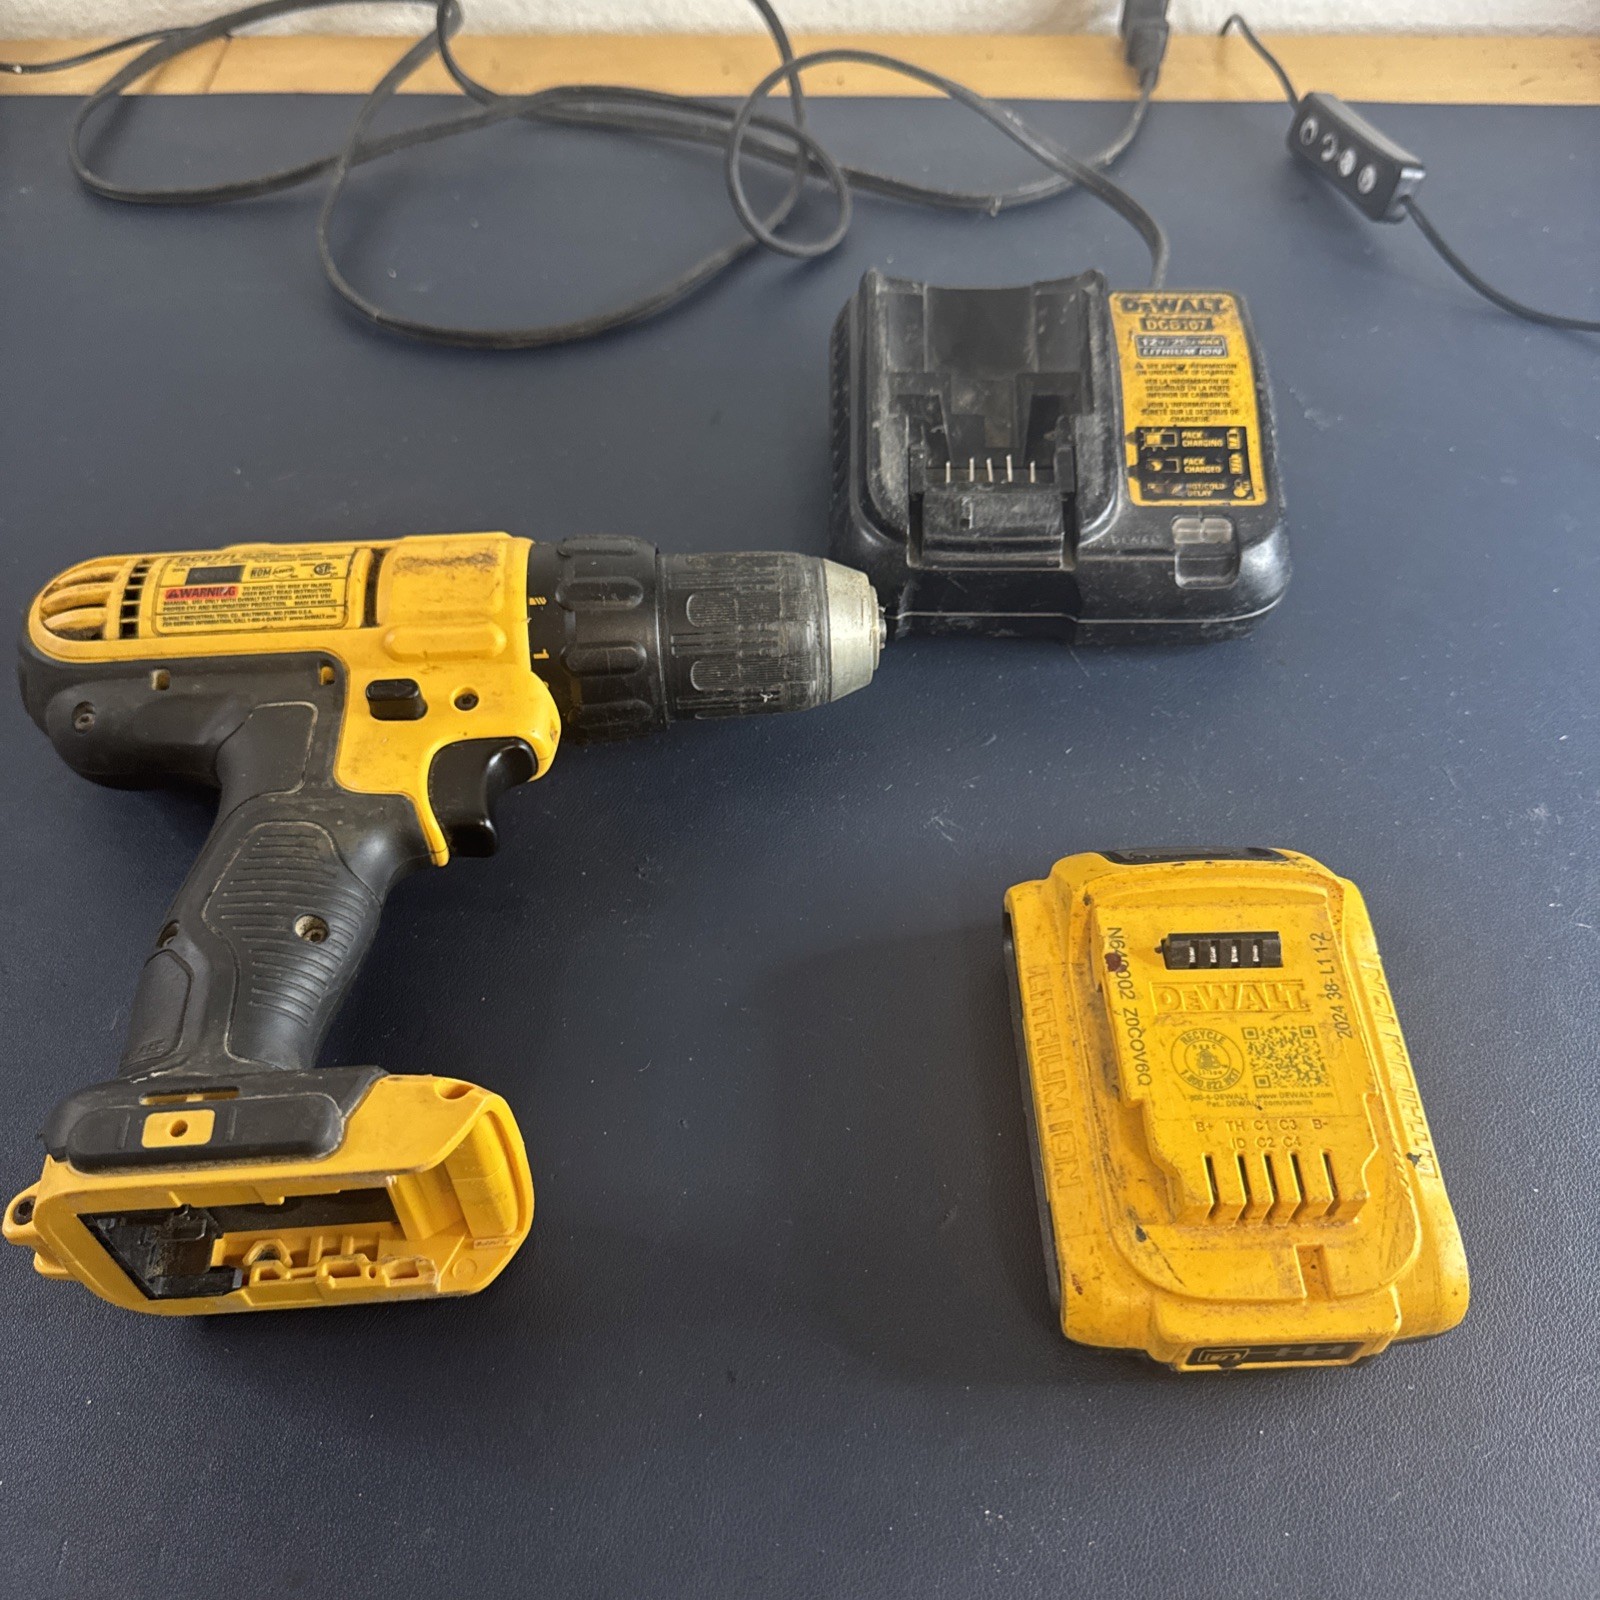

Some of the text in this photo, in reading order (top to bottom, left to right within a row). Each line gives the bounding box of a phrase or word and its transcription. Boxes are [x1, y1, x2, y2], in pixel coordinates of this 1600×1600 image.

[1121, 298, 1224, 315] DEWALT
[1142, 348, 1196, 356] LITHIUM
[1181, 431, 1203, 439] PACK
[1182, 439, 1224, 447] CHARGING
[1184, 466, 1223, 474] CHARGED
[180, 585, 236, 597] WARNING
[1107, 927, 1136, 1000] N64002
[1153, 982, 1307, 1013] DEWALT
[1330, 1005, 1353, 1039] 2024
[1180, 1030, 1226, 1046] RECYCLE
[1361, 959, 1439, 1180] LITHIUM ION
[1027, 965, 1083, 1190] LITHIUM ION
[1195, 1118, 1329, 1133] B+ TH C1 C3 B-
[1231, 1136, 1302, 1149] ID C2 C4
